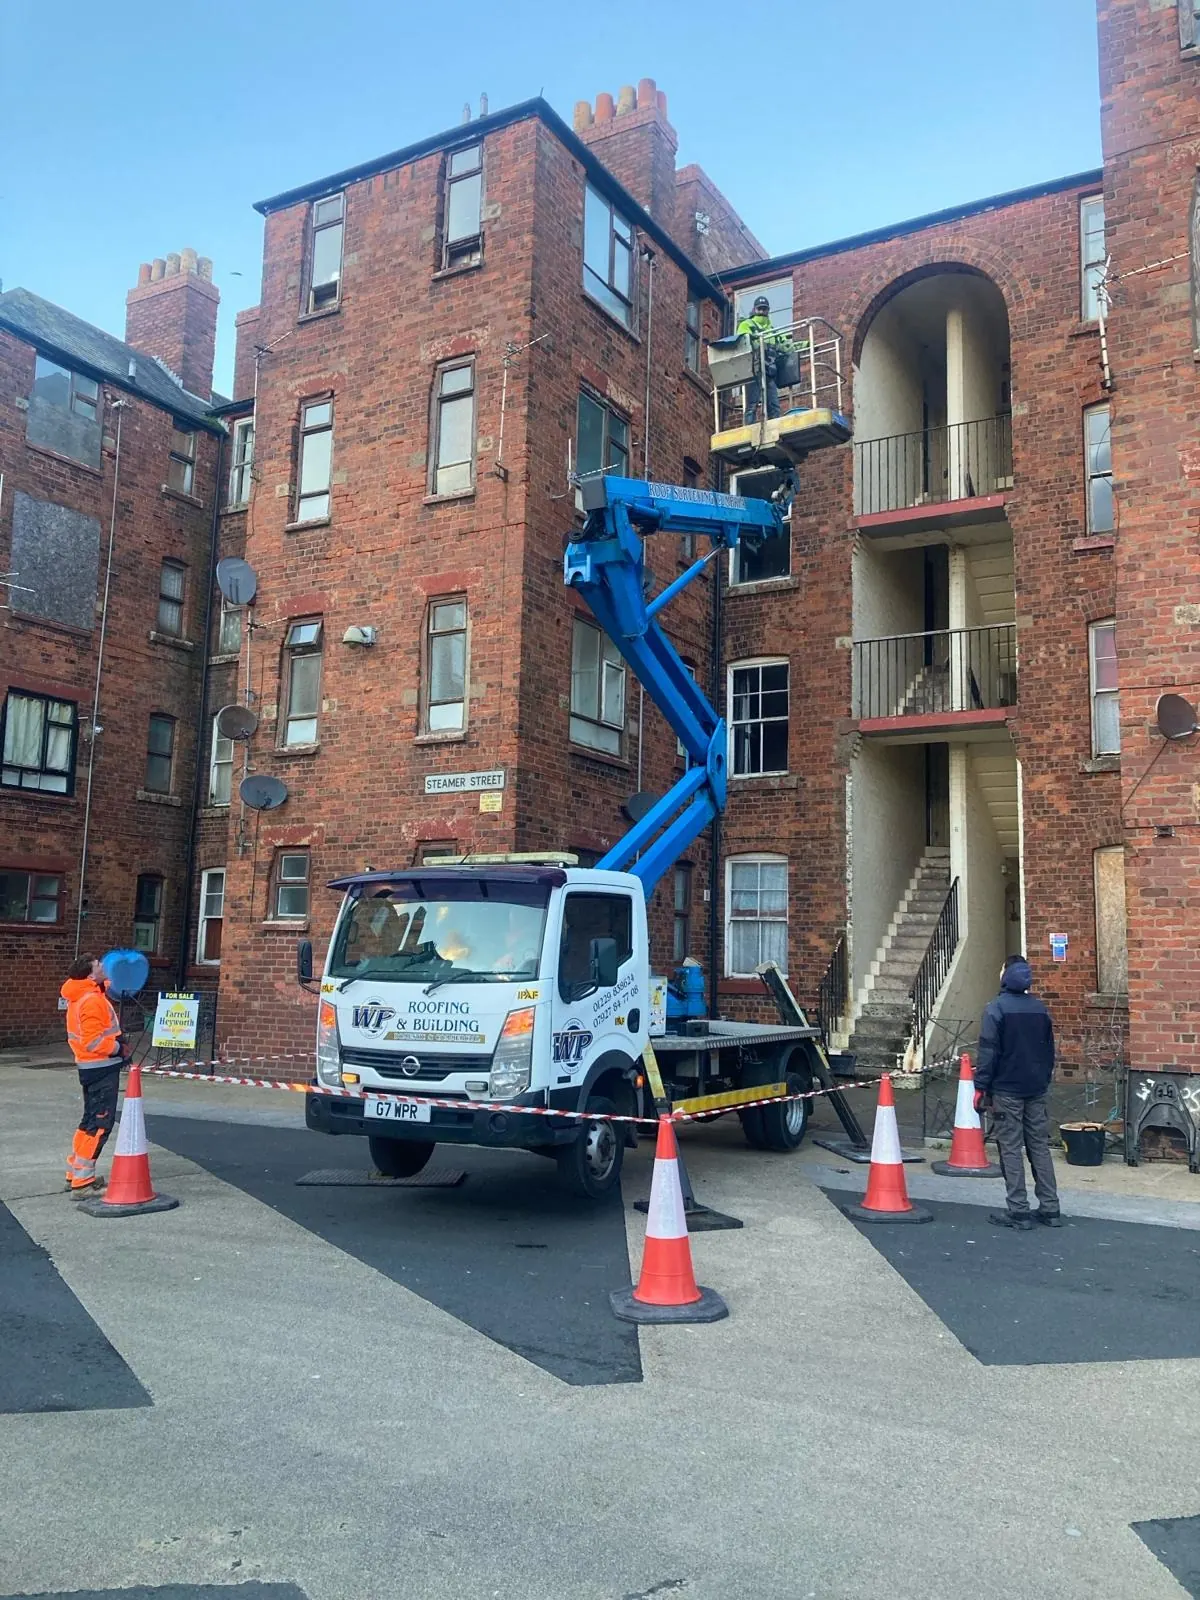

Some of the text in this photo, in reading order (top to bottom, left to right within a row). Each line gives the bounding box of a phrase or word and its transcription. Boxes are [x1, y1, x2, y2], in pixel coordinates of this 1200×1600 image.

[649, 484, 671, 498] ROOF
[427, 775, 503, 790] STEAMER STREET
[517, 988, 539, 1000] IPAF
[165, 1010, 190, 1018] Farrell
[408, 1001, 470, 1014] ROOFING
[159, 1017, 194, 1027] Heyworth
[352, 1005, 396, 1030] WP
[396, 1018, 408, 1030] &
[552, 1030, 593, 1063] WP
[376, 1101, 418, 1119] G7 WPR
